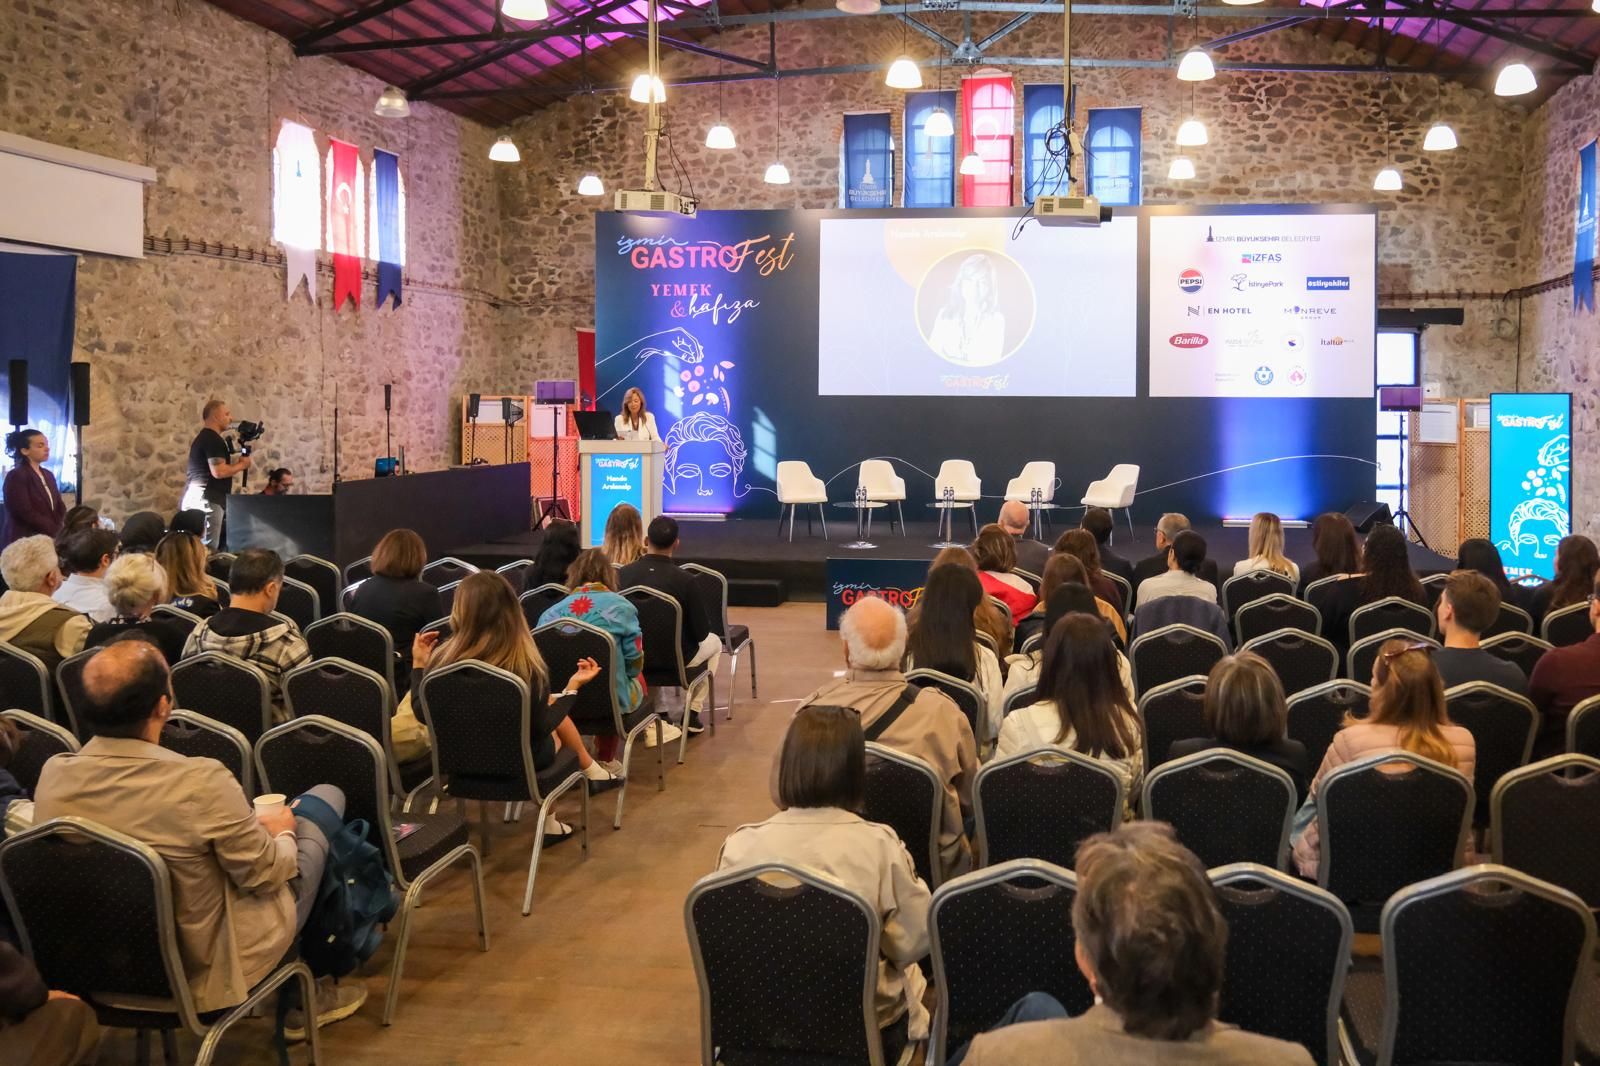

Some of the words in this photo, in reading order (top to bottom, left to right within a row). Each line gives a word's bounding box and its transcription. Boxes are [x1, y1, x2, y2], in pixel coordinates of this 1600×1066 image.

[616, 234, 689, 255] izmir
[651, 283, 712, 297] YEMEK
[670, 300, 688, 318] &
[1207, 307, 1220, 315] EN
[1222, 307, 1252, 315] HOTEL
[1174, 336, 1204, 345] Barilla
[1502, 566, 1533, 576] EMEK
